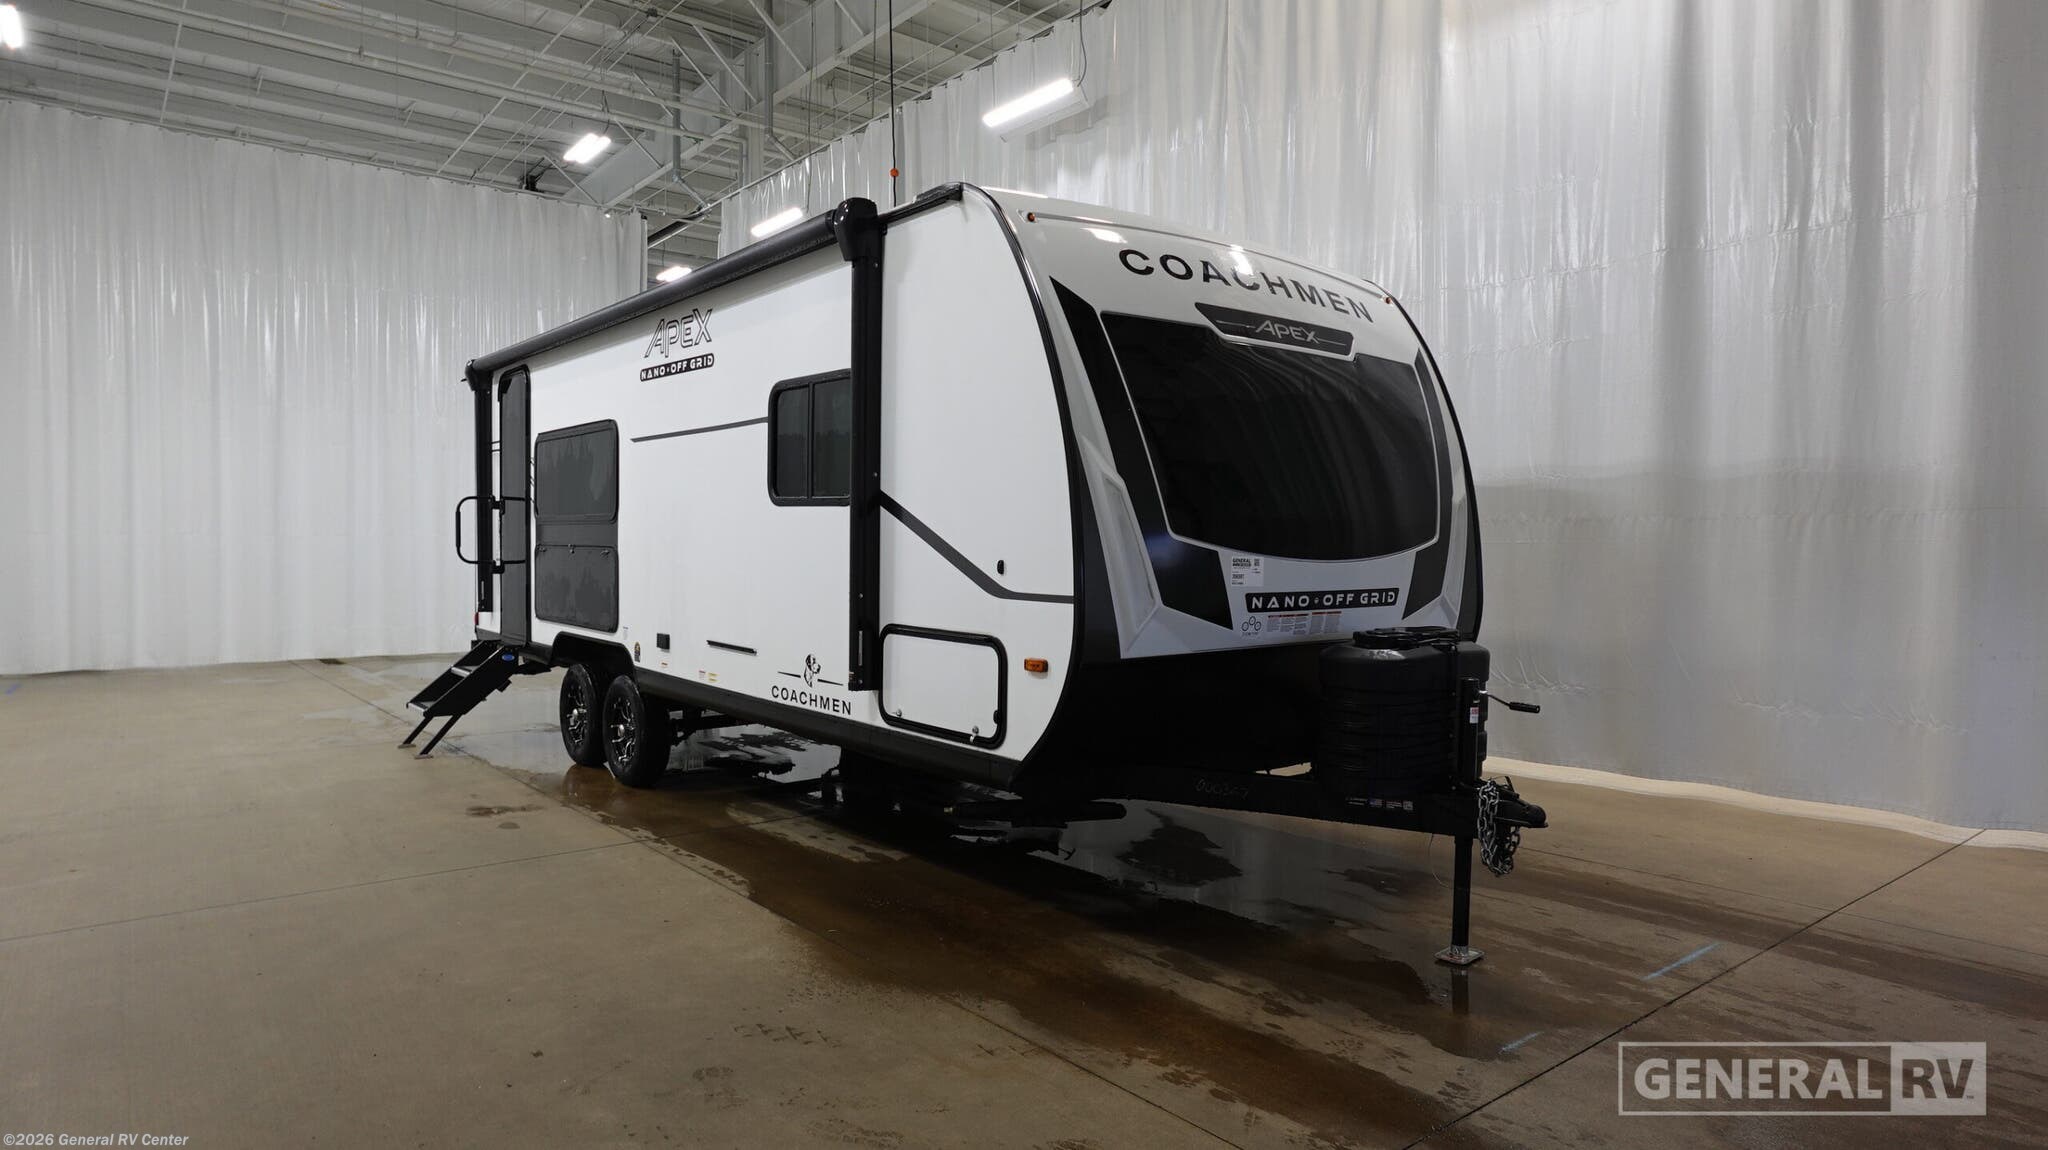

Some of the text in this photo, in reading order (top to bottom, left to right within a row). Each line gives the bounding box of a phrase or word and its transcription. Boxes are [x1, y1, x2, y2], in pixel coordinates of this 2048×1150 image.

[1119, 248, 1374, 323] COACHMEN
[644, 308, 713, 358] APEX
[1255, 320, 1320, 344] APEX
[690, 355, 713, 369] GRID
[1360, 591, 1396, 604] GRID
[771, 685, 851, 715] COACHMEN
